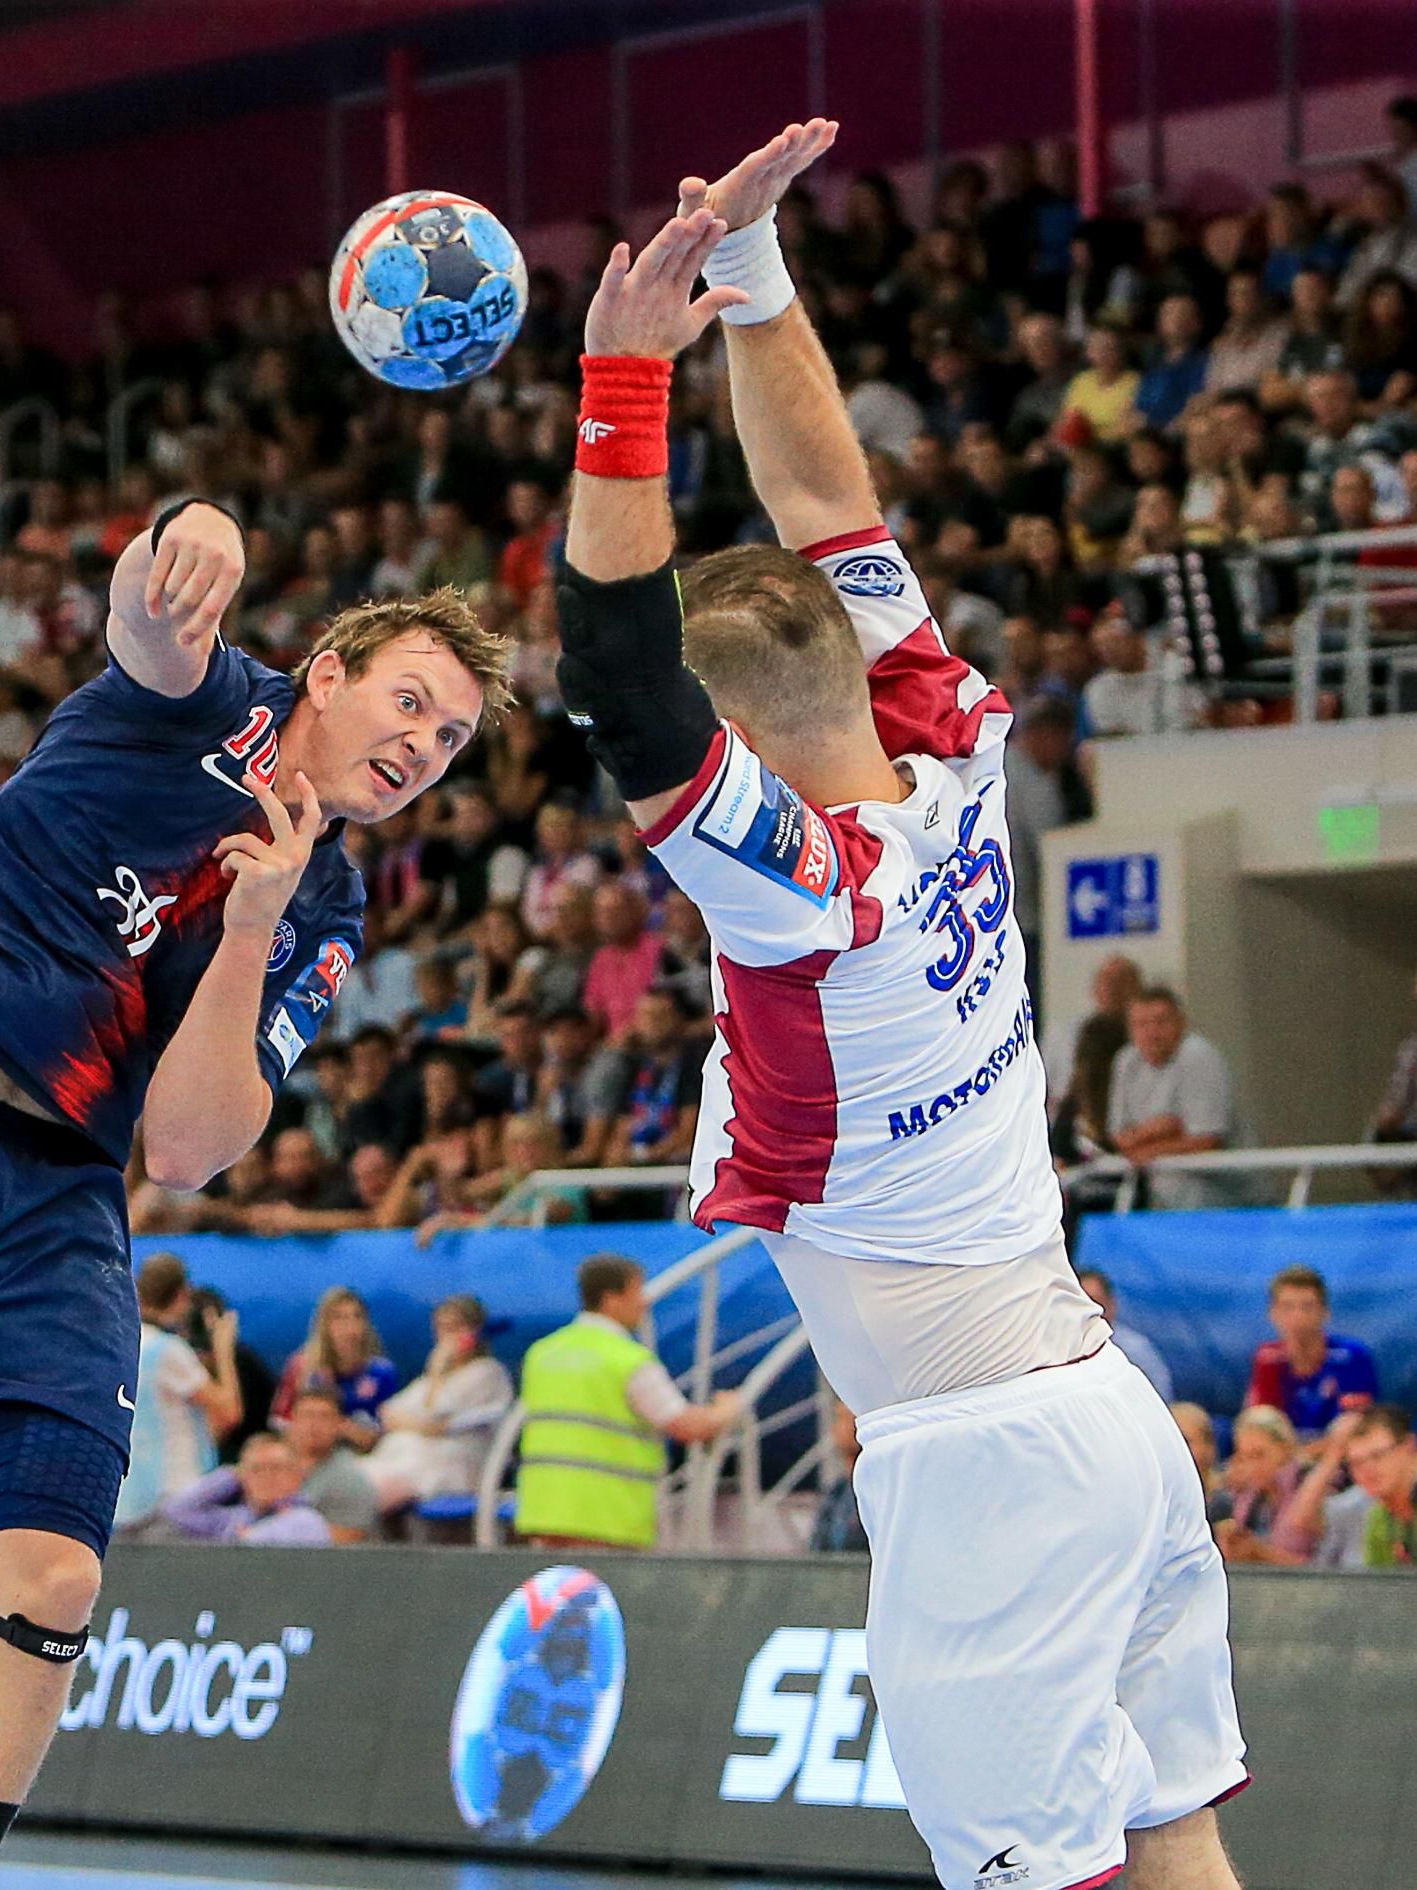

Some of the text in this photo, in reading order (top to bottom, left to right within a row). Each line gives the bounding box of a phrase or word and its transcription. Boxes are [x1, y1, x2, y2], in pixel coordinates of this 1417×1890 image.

[416, 286, 515, 347] SELECT
[222, 705, 279, 788] 10
[772, 811, 788, 846] LEAGUE
[776, 805, 797, 859] CHAMPIONS
[41, 1640, 79, 1657] SELECT
